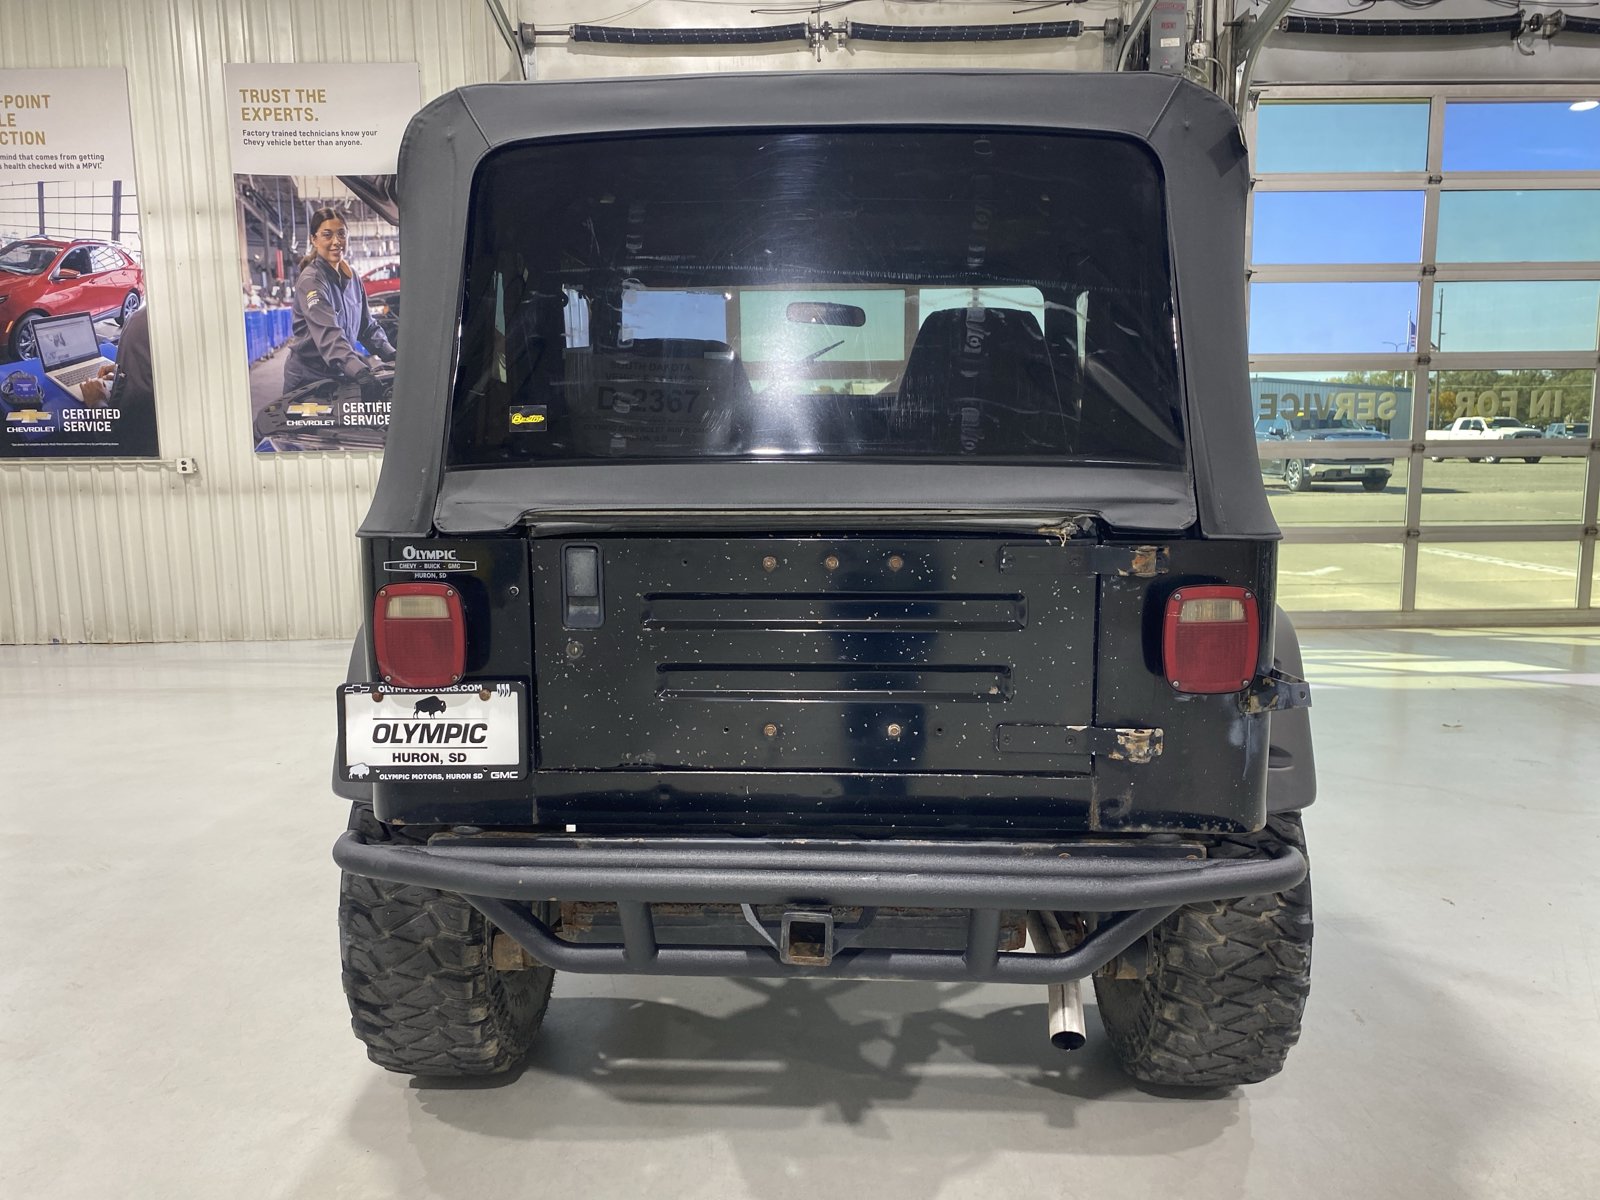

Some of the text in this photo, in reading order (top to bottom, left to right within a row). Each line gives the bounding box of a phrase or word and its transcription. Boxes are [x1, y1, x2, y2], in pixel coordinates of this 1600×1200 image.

[239, 89, 327, 103] TRUST THE
[241, 107, 319, 122] EXPERTS.
[242, 129, 270, 138] Factory
[271, 129, 297, 137] trained
[299, 129, 339, 137] technicians
[361, 130, 378, 138] your
[243, 139, 265, 147] Chevy
[79, 153, 105, 162] getting
[342, 402, 392, 413] CERTIFIE
[62, 408, 121, 420] CERTIFIED
[343, 414, 390, 426] SERVICE
[63, 421, 112, 432] SERVICE
[402, 545, 457, 560] OLYMPIC
[372, 723, 488, 744] OLYMPIC
[392, 752, 467, 765] HURON, SD
[490, 771, 519, 779] GMC
